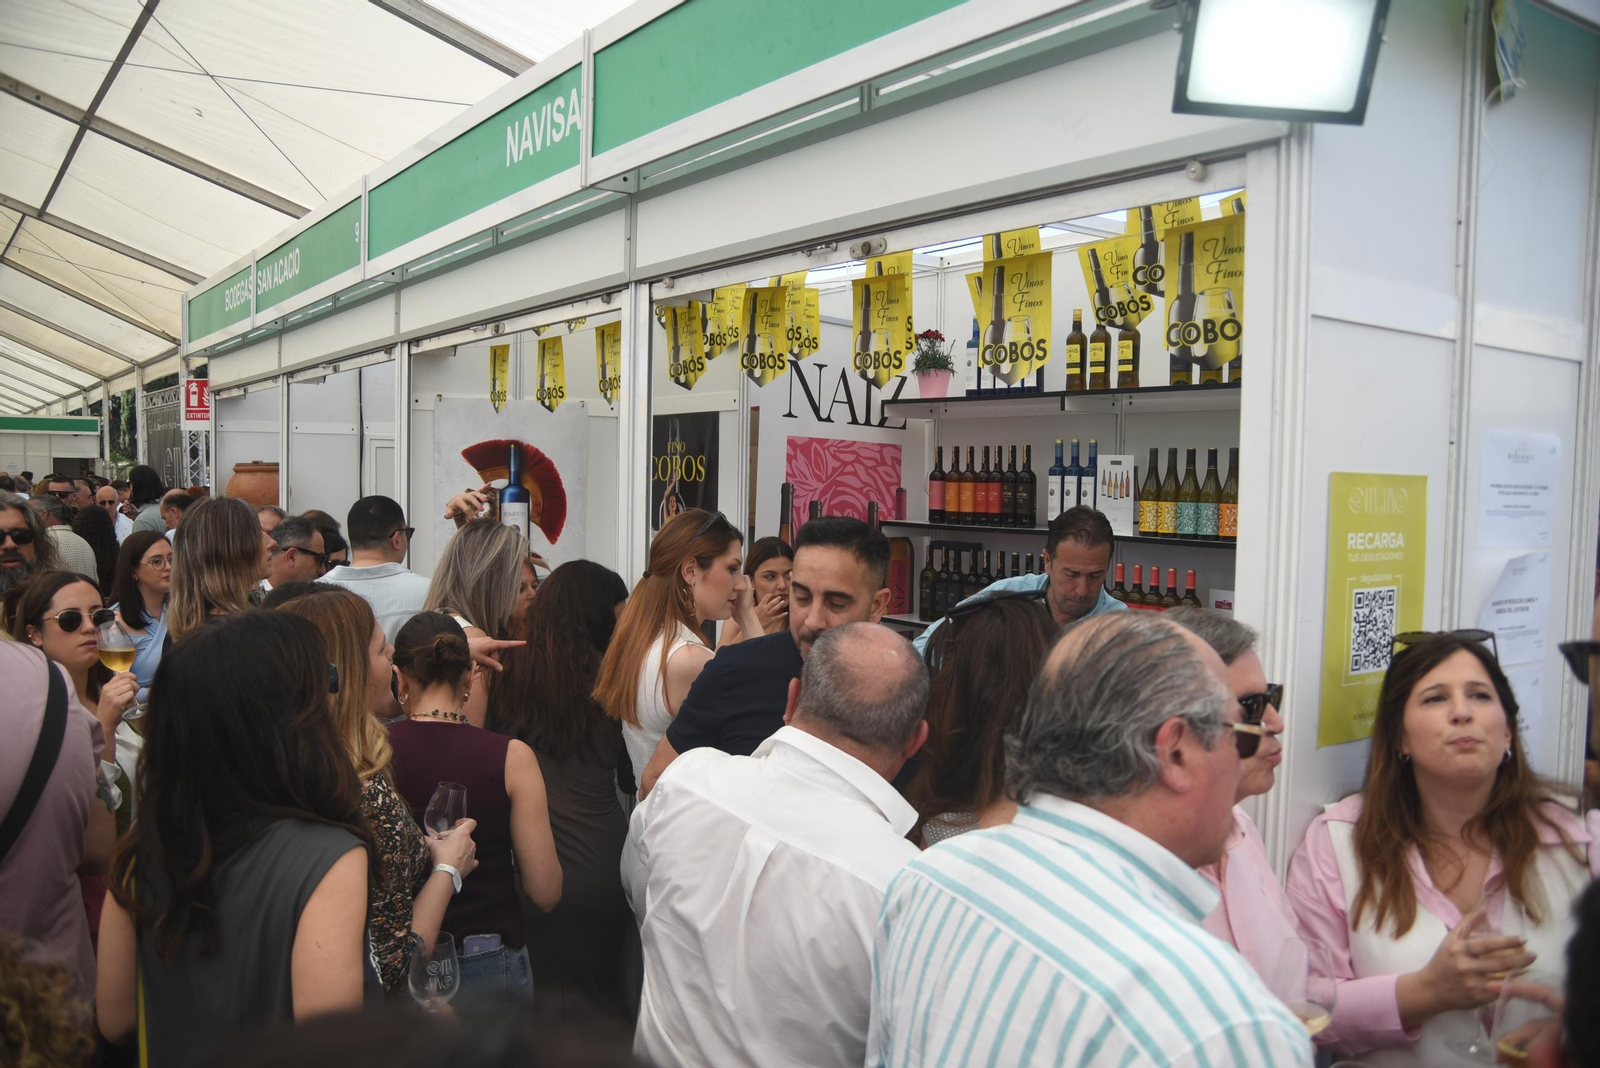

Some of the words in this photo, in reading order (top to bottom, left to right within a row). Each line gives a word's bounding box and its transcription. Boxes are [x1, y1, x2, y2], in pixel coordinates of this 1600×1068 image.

[506, 87, 581, 167] NAVISA
[1163, 210, 1195, 228] Finos
[354, 222, 359, 243] 9
[1006, 237, 1035, 254] Vinos
[1103, 250, 1129, 265] Vino
[224, 275, 253, 312] BODEGAS
[257, 267, 272, 295] SAN
[273, 247, 300, 288] ACACIO
[1110, 263, 1129, 280] Fin
[1010, 271, 1045, 292] Vinos
[875, 290, 900, 307] Vinos
[1012, 291, 1043, 312] Finos
[877, 307, 899, 325] Finos
[1095, 294, 1152, 323] COBOS
[702, 332, 727, 347] OBOS
[1165, 317, 1243, 348] COBO
[740, 352, 786, 371] COBOS
[853, 349, 903, 371] COBOS
[981, 338, 1048, 366] COBOS
[669, 355, 705, 379] COBOS
[536, 385, 565, 401] COBOS
[667, 441, 686, 453] FINO
[1347, 532, 1405, 550] RECARGA
